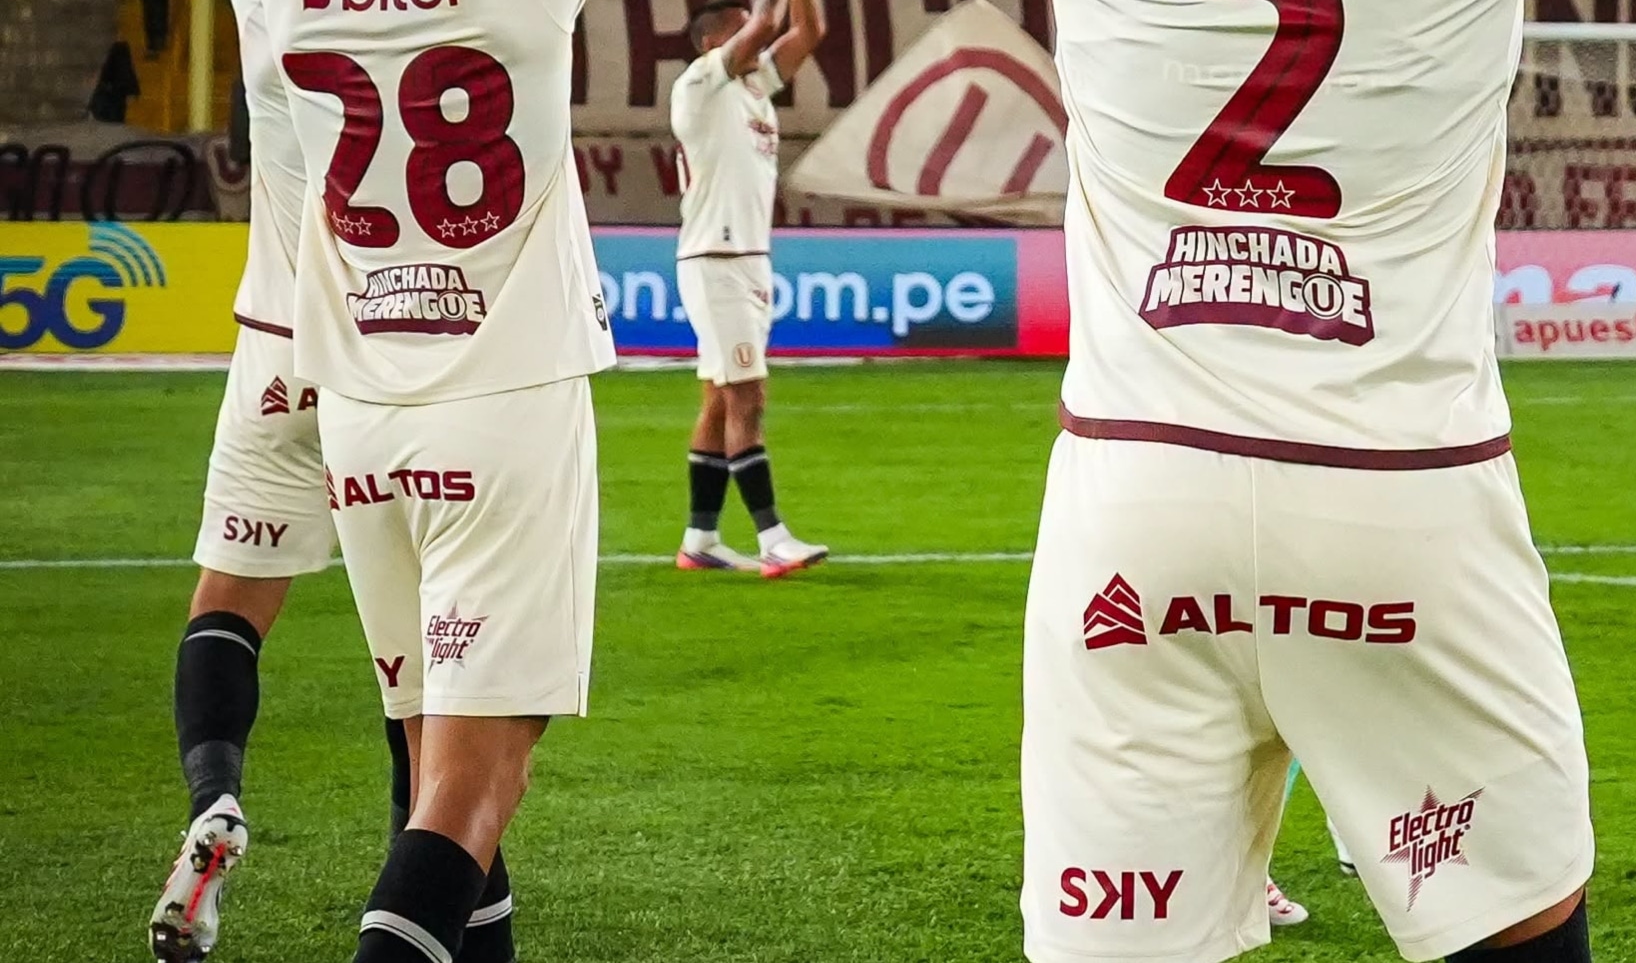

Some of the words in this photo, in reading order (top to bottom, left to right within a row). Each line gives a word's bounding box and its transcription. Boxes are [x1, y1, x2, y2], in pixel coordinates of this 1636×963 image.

[281, 45, 526, 249] 28
[1171, 230, 1343, 276] HINCHADA
[0, 255, 126, 349] 5G
[347, 290, 486, 322] MERENGUE
[1145, 264, 1368, 329] MERENGUE
[344, 470, 476, 507] ALTOS
[223, 515, 289, 548] SKY
[427, 615, 481, 637] Electro
[1158, 594, 1417, 644] ALTOS
[430, 636, 470, 665] light
[1388, 799, 1475, 853] Electro
[1411, 828, 1465, 879] light
[1058, 867, 1184, 920] SKY
